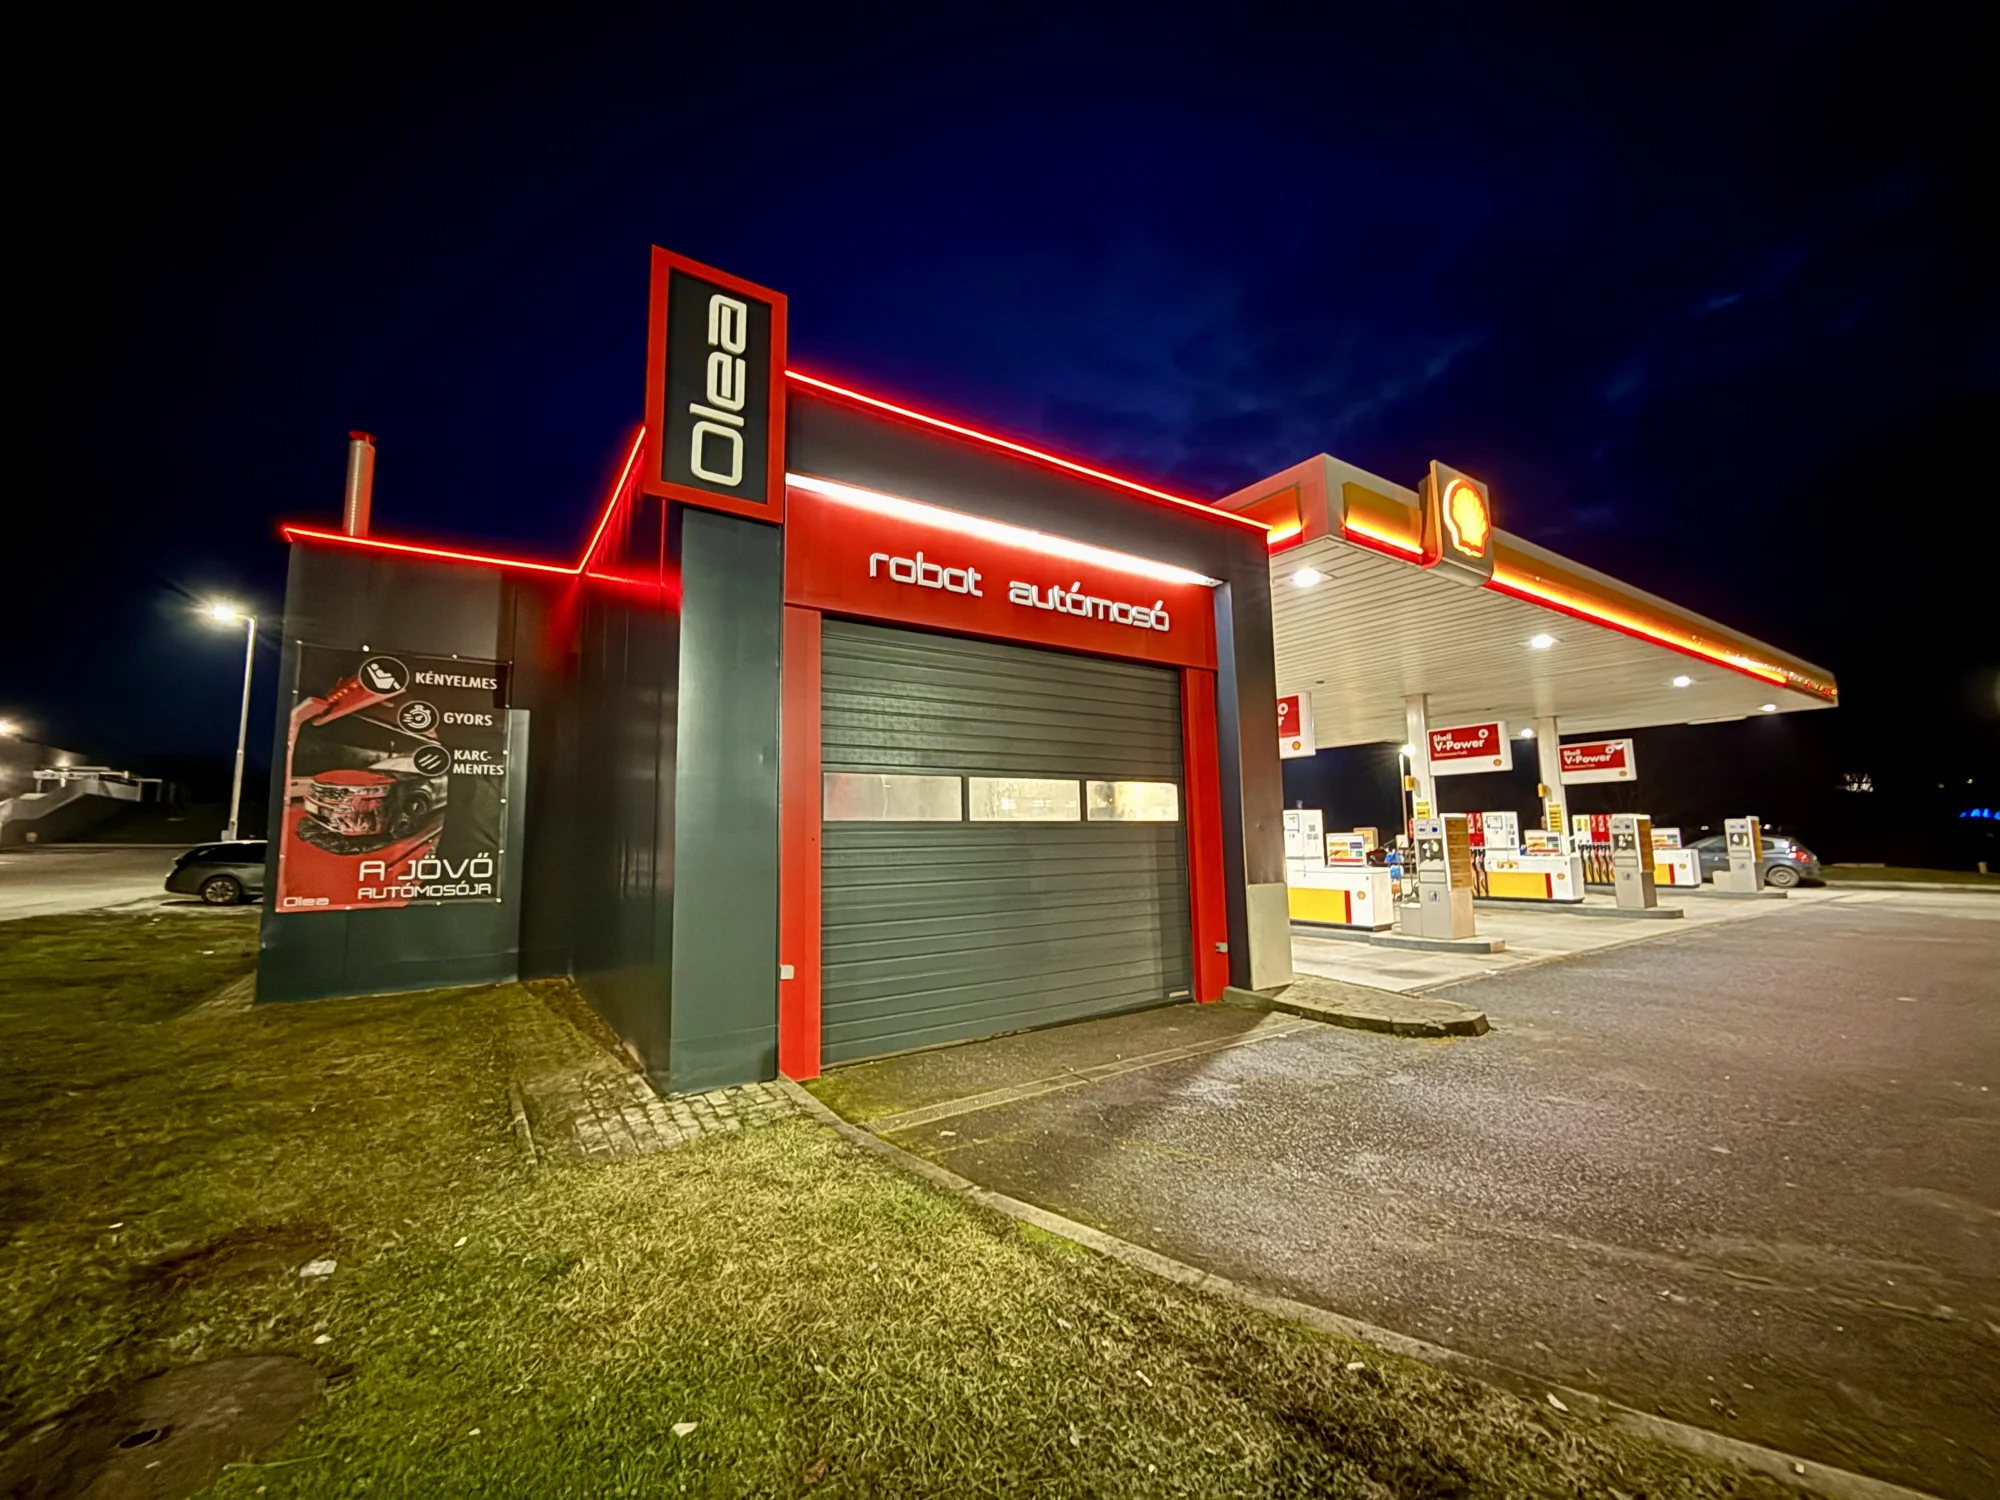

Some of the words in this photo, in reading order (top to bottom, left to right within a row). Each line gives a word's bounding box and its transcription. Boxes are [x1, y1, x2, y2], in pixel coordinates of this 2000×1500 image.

[689, 293, 747, 487] Olea
[869, 551, 983, 598] robot
[1008, 581, 1170, 632] autómosó
[415, 670, 498, 690] KÉNYELMES
[443, 711, 493, 727] GYORS
[1434, 740, 1485, 752] V-Power
[454, 749, 492, 762] KARC-
[1564, 754, 1611, 765] V-Power
[452, 763, 504, 776] MENTES
[359, 860, 385, 881] A
[398, 852, 493, 880] JÖVŐ
[358, 881, 492, 899] AUTÓMOSÓJA
[283, 896, 330, 907] Olea
